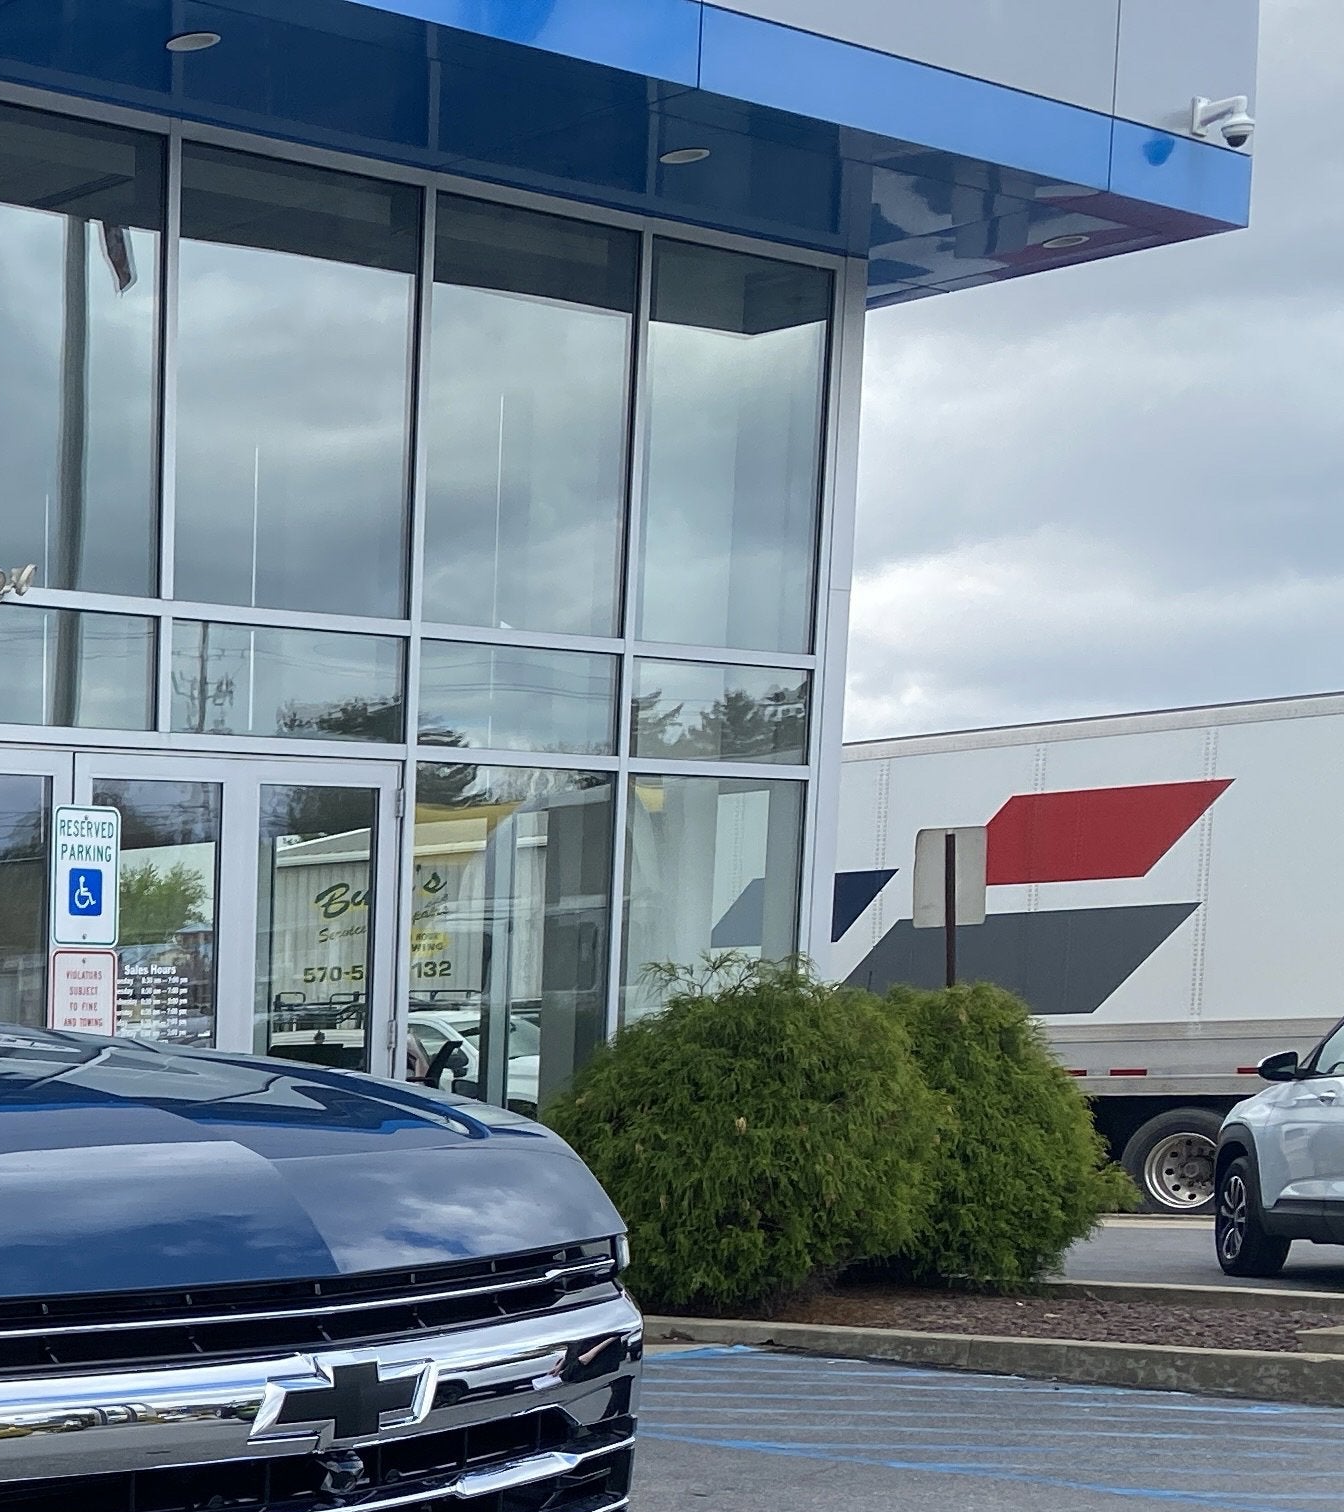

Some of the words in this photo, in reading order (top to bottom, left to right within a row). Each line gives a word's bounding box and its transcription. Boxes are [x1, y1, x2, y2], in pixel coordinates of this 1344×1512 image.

[59, 819, 114, 839] RESERVED
[61, 843, 112, 862] PARKING
[124, 965, 149, 975] Sales
[150, 964, 177, 974] Hours
[66, 970, 102, 981] VIOLATORS
[69, 986, 98, 996] SUBJECT
[69, 1002, 78, 1012] TO
[82, 1002, 98, 1012] FINE
[63, 1017, 77, 1028] AND
[79, 1017, 103, 1027] TOWING
